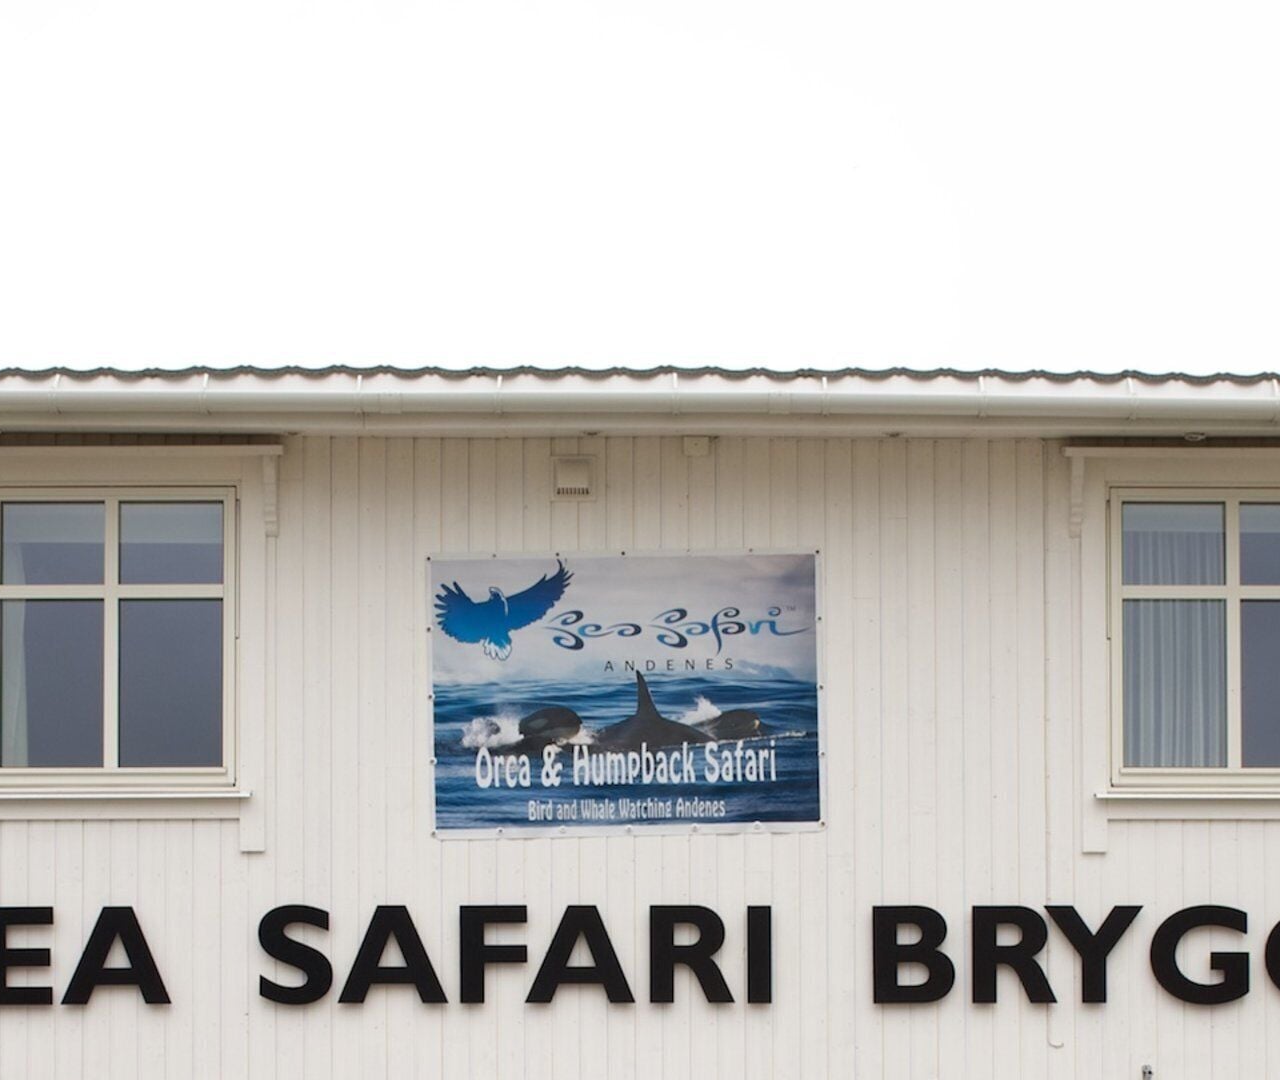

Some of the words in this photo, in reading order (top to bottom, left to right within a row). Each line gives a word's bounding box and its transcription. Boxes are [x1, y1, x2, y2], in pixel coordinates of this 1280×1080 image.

[543, 609, 642, 650] Sea
[649, 606, 811, 656] Safari
[604, 658, 734, 673] ANDENES
[475, 746, 531, 788] Orca
[541, 743, 564, 787] &
[573, 741, 696, 787] Humpback
[704, 740, 777, 783] Safari
[528, 799, 553, 821] Bird
[556, 800, 577, 820] and
[581, 799, 615, 819] Whale
[619, 798, 672, 819] Watching
[675, 797, 726, 818] Andenes
[258, 904, 773, 1005] SAFARI
